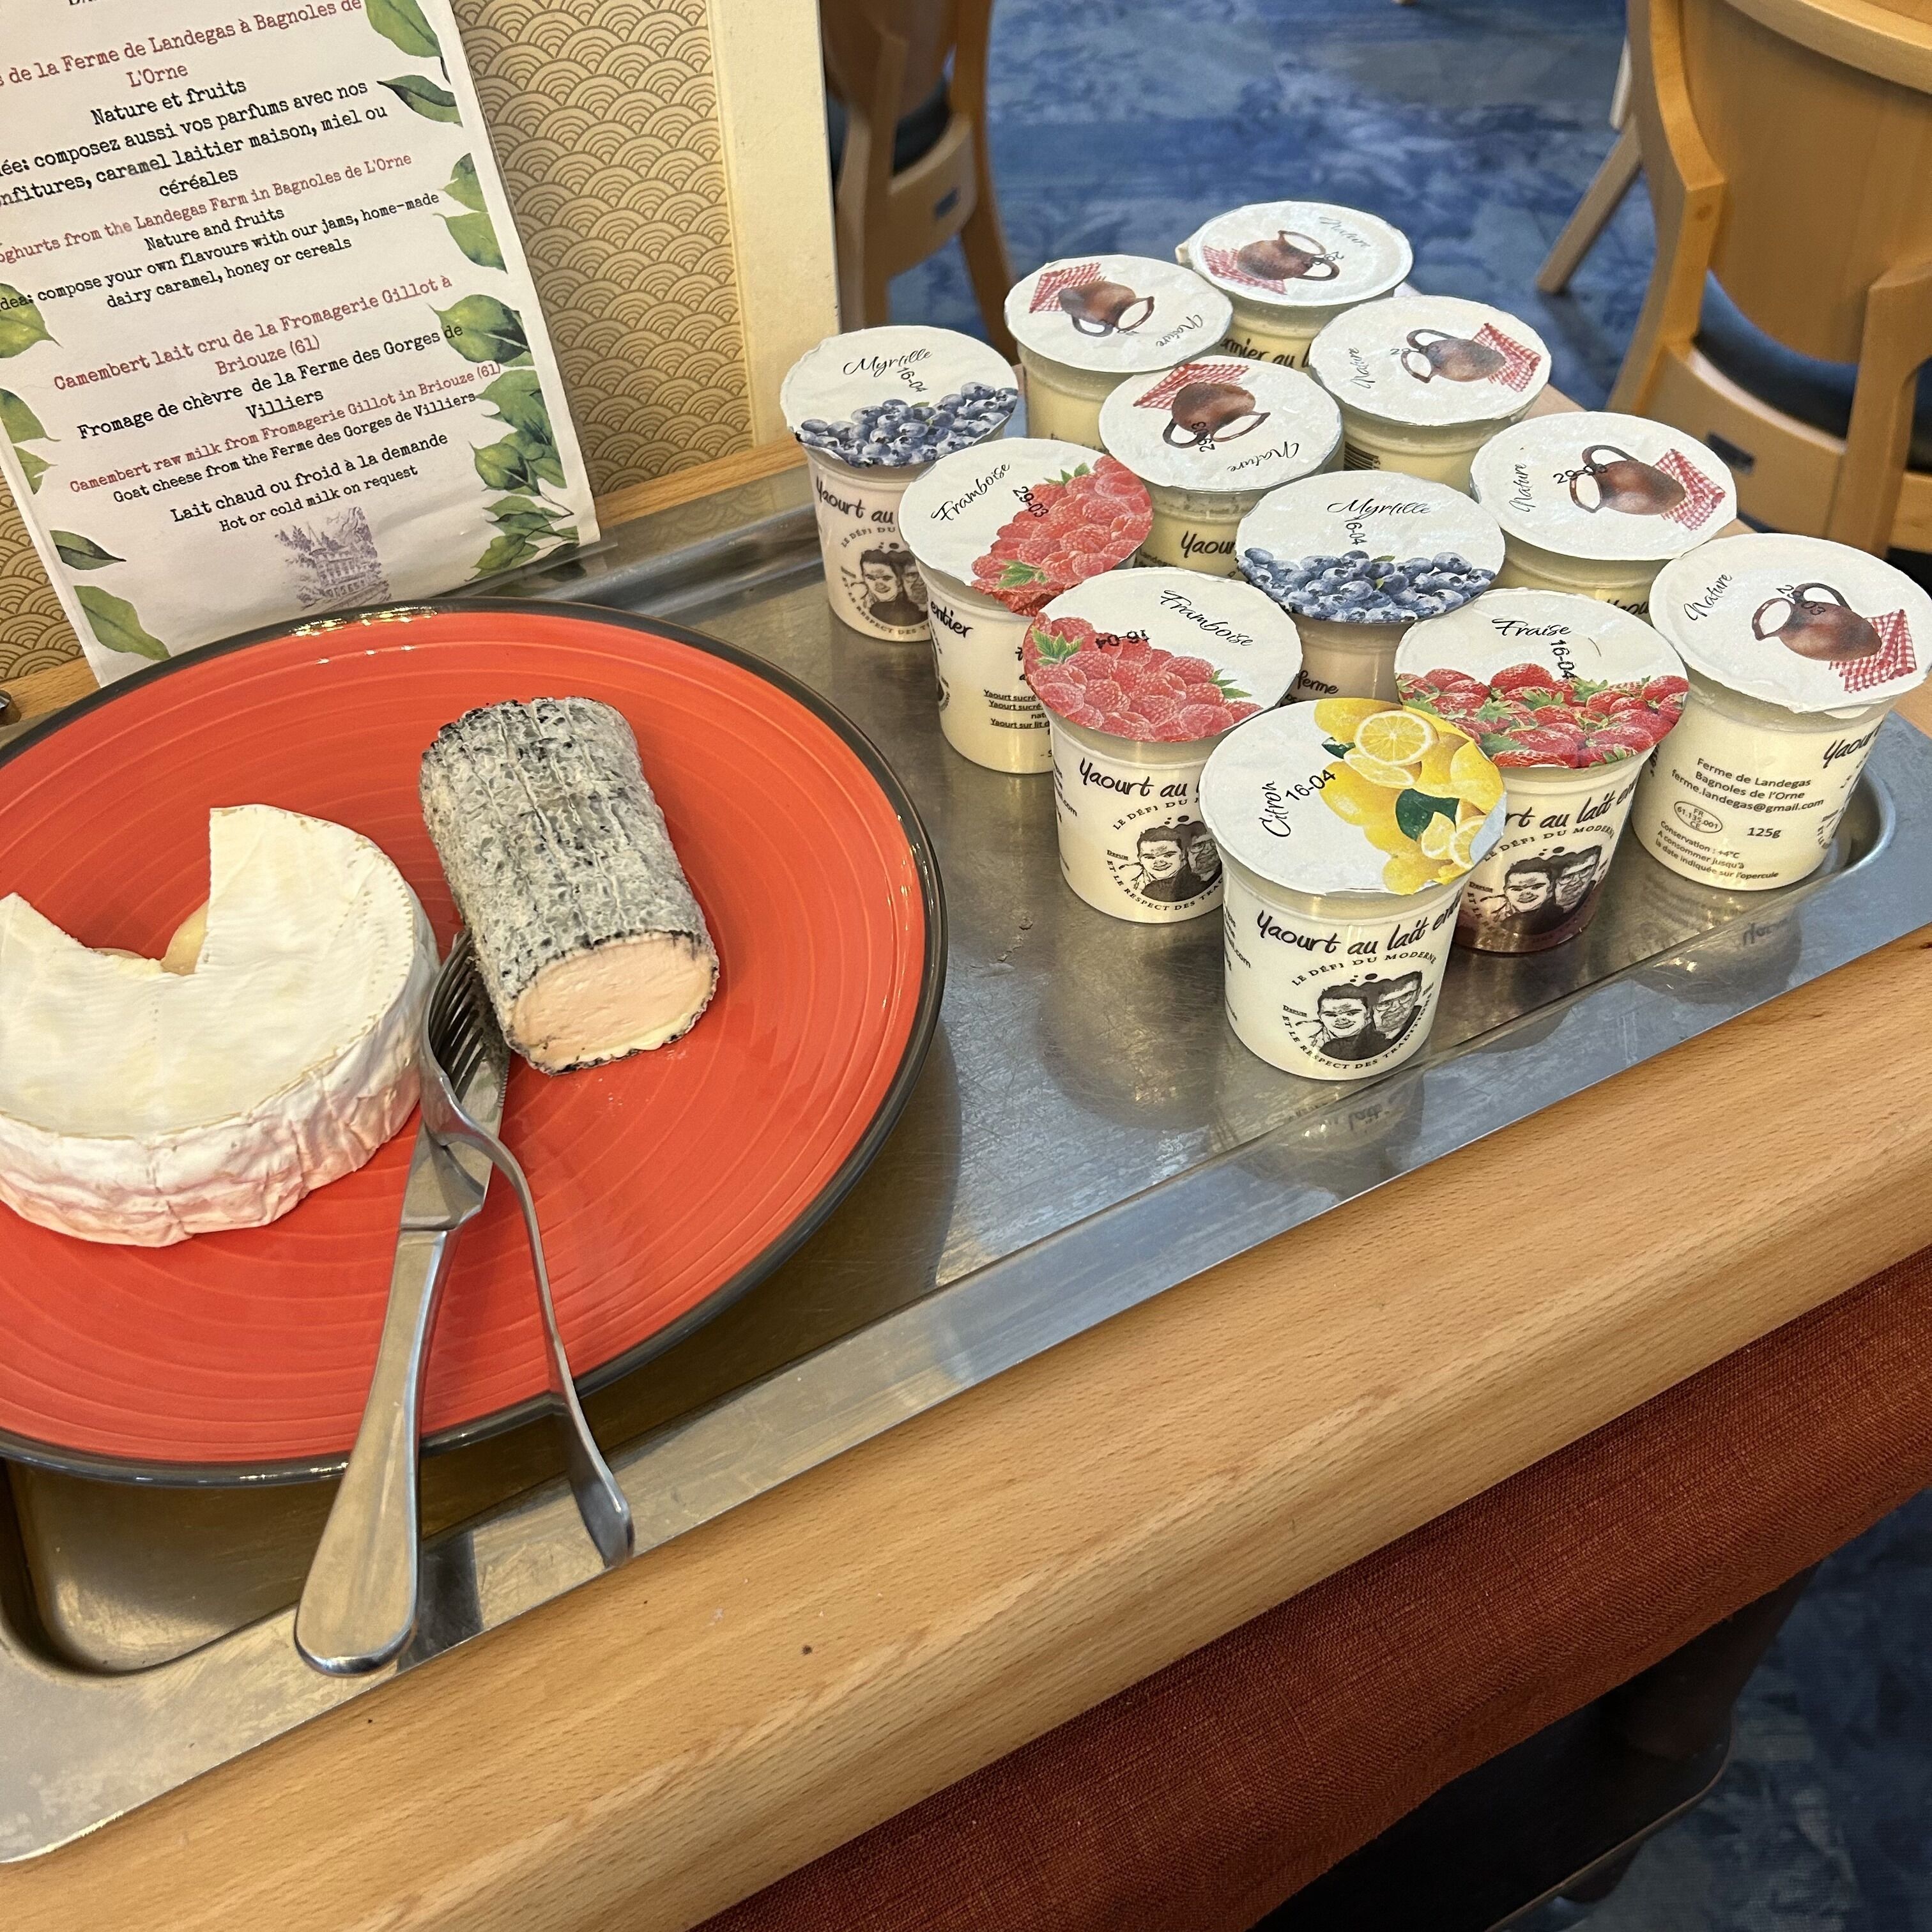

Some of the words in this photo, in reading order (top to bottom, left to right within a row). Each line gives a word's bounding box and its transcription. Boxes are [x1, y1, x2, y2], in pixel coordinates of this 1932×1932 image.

[9, 67, 33, 84] de
[34, 62, 60, 78] la
[61, 49, 120, 72] Ferme
[123, 42, 147, 58] de
[148, 24, 236, 53] Landegas
[239, 18, 252, 33] à
[254, 2, 337, 31] Bagnoles
[126, 65, 188, 88] L'Orne
[90, 101, 158, 125] Nature
[162, 93, 183, 109] et
[186, 79, 247, 105] fruits
[0, 158, 30, 177] ée:
[34, 138, 121, 167] composez
[125, 123, 180, 148] aussi
[180, 116, 213, 134] vos
[216, 99, 289, 130] parfums
[293, 88, 334, 109] avec
[337, 80, 368, 100] nos
[0, 175, 93, 206] nfitures,
[96, 153, 171, 183] caramel
[171, 139, 244, 165] laitier
[249, 124, 318, 148] maison,
[321, 110, 363, 132] miel
[365, 105, 388, 120] ou
[159, 168, 239, 197] céréales
[0, 237, 61, 264] oghurts
[64, 230, 102, 247] from
[104, 221, 133, 238] the
[134, 203, 208, 230] Landegas
[208, 194, 249, 211] Farm
[251, 186, 272, 202] in
[272, 171, 342, 197] Bagnoles
[344, 165, 363, 180] de
[363, 154, 412, 174] L'Orne
[1319, 217, 1371, 247] Nature
[54, 355, 151, 390] Camembert
[151, 343, 194, 366] lait
[198, 337, 230, 354] cru
[233, 329, 254, 344] de
[255, 323, 279, 339] la
[279, 296, 379, 332] Fromagerie
[382, 278, 440, 304] Gillot
[440, 275, 453, 289] à
[1156, 314, 1203, 347] Nature
[215, 347, 288, 376] Briouze
[289, 334, 320, 356] (61)
[843, 348, 933, 378] Myrtille
[1349, 347, 1376, 389] Nature
[896, 367, 929, 393] 16-04
[70, 462, 151, 493] Camembert
[154, 455, 183, 470] raw
[185, 443, 224, 463] milk
[224, 434, 259, 451] from
[260, 409, 346, 441] Fromagerie
[348, 395, 397, 417] Gillot
[398, 388, 417, 402] in
[418, 372, 475, 395] Briouze
[477, 362, 501, 381] (61)
[113, 484, 150, 503] Goat
[153, 471, 203, 493] cheese
[205, 460, 241, 477] from
[242, 451, 269, 467] the
[269, 439, 314, 459] Ferme
[317, 430, 341, 446] des
[344, 416, 392, 437] Gorges
[395, 411, 412, 423] de
[413, 392, 477, 417] Villiers
[1227, 441, 1300, 472] Nature
[170, 500, 212, 523] Lait
[215, 484, 268, 510] chaud
[270, 479, 292, 494] ou
[295, 463, 343, 487] froid
[343, 459, 356, 472] à
[356, 454, 379, 469] la
[381, 434, 448, 462] demande
[931, 463, 1011, 522] Framboise
[1509, 463, 1537, 512] Nature
[219, 515, 247, 532] Hot
[250, 511, 267, 523] or
[270, 498, 303, 517] cold
[306, 488, 341, 507] milk
[344, 484, 362, 495] on
[364, 464, 418, 490] request
[816, 475, 865, 519] Yaourt
[871, 510, 894, 524] au
[1013, 486, 1049, 518] 29-03
[1327, 498, 1432, 521] Myrtille
[1181, 531, 1236, 558] Yaour
[1344, 516, 1367, 546] 16-04
[1683, 573, 1733, 621] Nature
[931, 601, 974, 638] entier
[1160, 590, 1255, 647] Framboise
[1492, 618, 1572, 637] Fraise
[1095, 629, 1151, 649] 16-04
[1549, 640, 1578, 680] 16-04
[983, 689, 1012, 702] Yaourt
[1297, 670, 1339, 694] ferme
[988, 700, 1016, 710] Yaourt
[990, 717, 1017, 729] Yaourt
[1079, 757, 1154, 797] Yaourt
[1160, 783, 1188, 798] au
[1285, 769, 1337, 802] 16-04
[1671, 769, 1824, 813] ferme.landegas@gmail.com
[1695, 771, 1747, 796] Bagnoles
[1749, 788, 1765, 799] de
[1768, 791, 1805, 800] l'Orne
[1697, 758, 1733, 779] Ferme
[1736, 774, 1751, 784] de
[1754, 778, 1811, 789] Landegas
[1113, 819, 1126, 831] LE
[1126, 804, 1159, 820] DÉFI
[1165, 799, 1188, 809] DU
[1259, 780, 1292, 838] Citron
[1540, 813, 1570, 829] au
[1576, 790, 1616, 824] lait
[1690, 820, 1700, 830] CE
[1693, 808, 1704, 817] FR
[1660, 820, 1710, 852] Conservation
[1664, 836, 1711, 862] consommer
[1747, 827, 1782, 839] 125g
[1655, 838, 1662, 848] la
[1662, 845, 1679, 859] date
[1680, 855, 1718, 875] indiquée
[1107, 859, 1117, 873] ET
[1114, 875, 1124, 887] LE
[1124, 888, 1170, 912] RESPECT
[1174, 901, 1196, 911] DES
[1257, 910, 1342, 954] Yaourt
[1347, 939, 1379, 955] au
[1386, 916, 1430, 951] lait
[1291, 974, 1307, 987] LE
[1308, 961, 1346, 976] DÉFI
[1352, 956, 1378, 966] DU
[1384, 951, 1437, 965] MODERNE
[1282, 1014, 1292, 1027] ET
[1288, 1029, 1301, 1043] LE
[1300, 1044, 1351, 1070] RESPECT
[1354, 1058, 1379, 1070] DES
